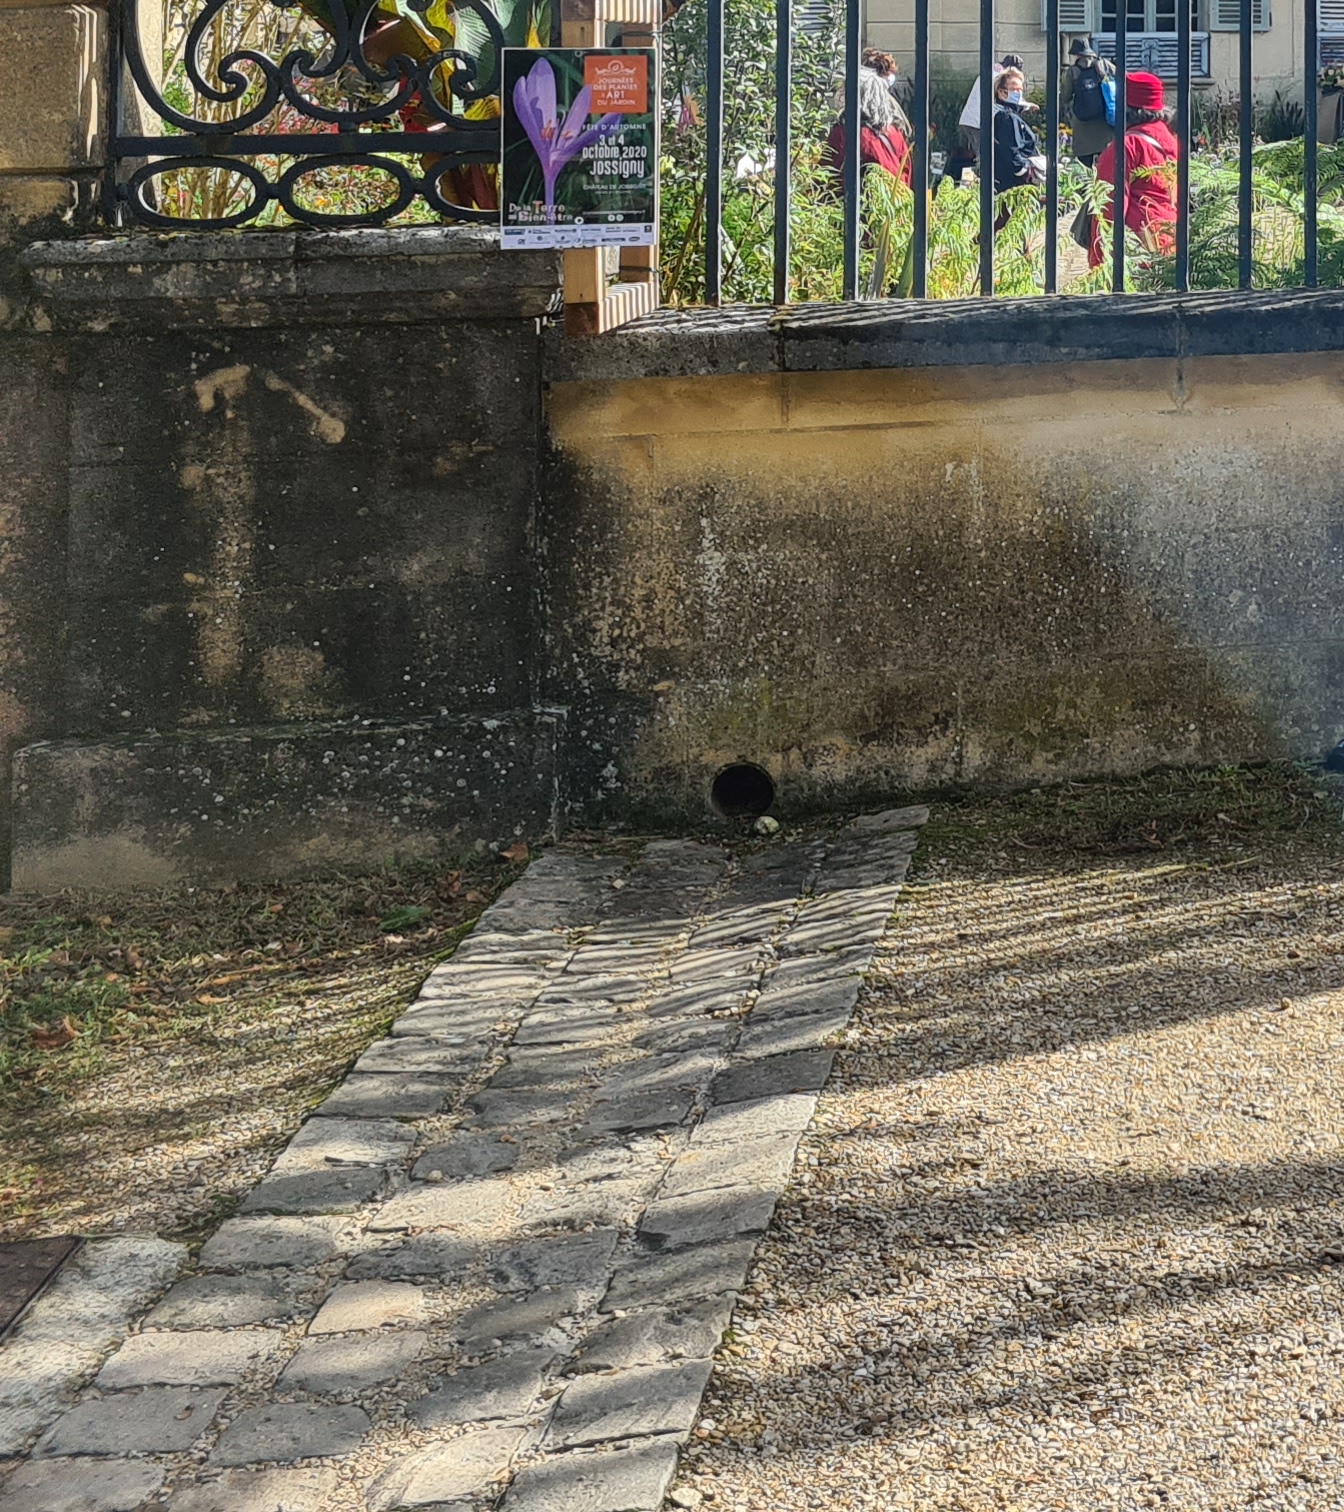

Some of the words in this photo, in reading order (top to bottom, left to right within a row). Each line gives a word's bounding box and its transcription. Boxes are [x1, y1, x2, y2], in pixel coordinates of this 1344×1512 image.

[606, 90, 626, 99] ART
[599, 134, 606, 146] 3
[618, 134, 625, 146] 4
[582, 143, 620, 159] octobre
[622, 146, 648, 158] 2020
[589, 157, 645, 179] Jossigny
